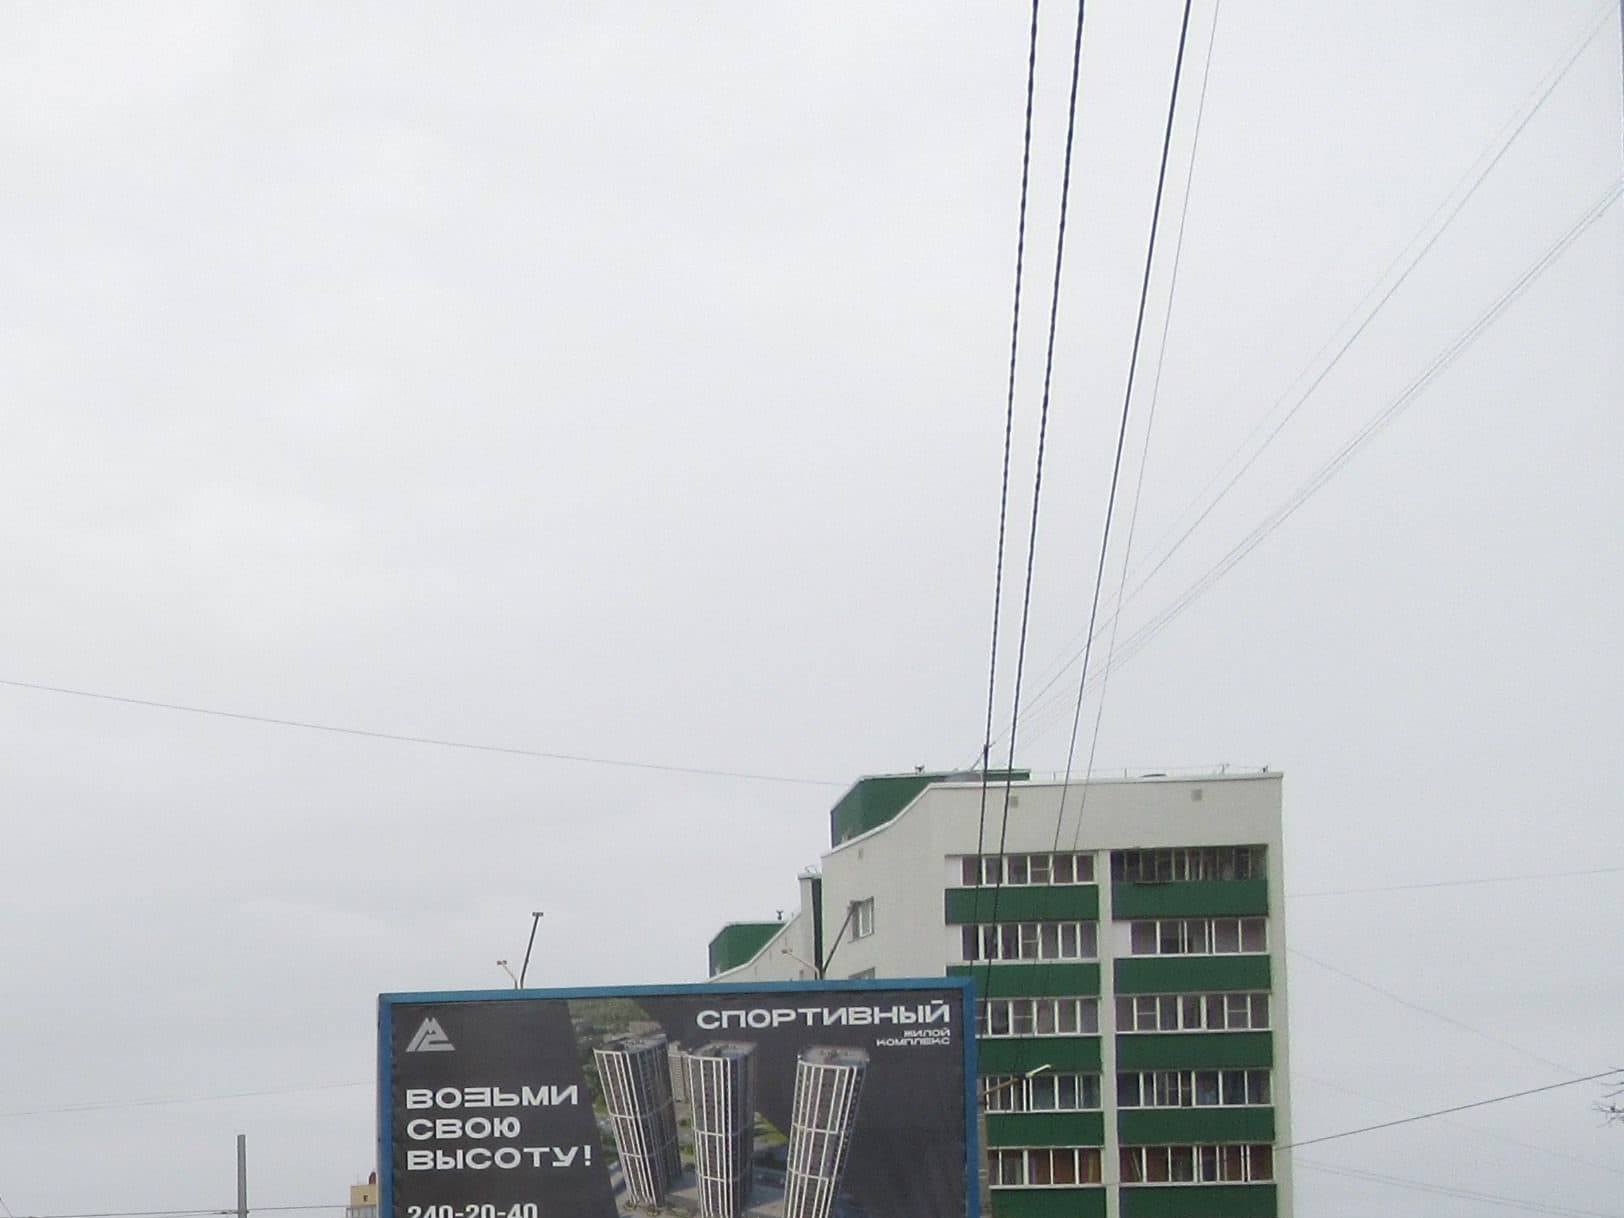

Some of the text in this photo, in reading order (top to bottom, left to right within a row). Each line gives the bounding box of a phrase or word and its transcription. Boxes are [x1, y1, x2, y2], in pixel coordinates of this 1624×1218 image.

[696, 1000, 951, 1030] СПОРТИВНЫЙ
[876, 1037, 951, 1047] КОМПЛЕКС
[903, 1028, 951, 1038] ЖИЛОЙ
[406, 1085, 579, 1110] ВОЗЬМИ
[406, 1116, 521, 1141] СВОЮ
[407, 1145, 592, 1171] ВЫСОТУ!
